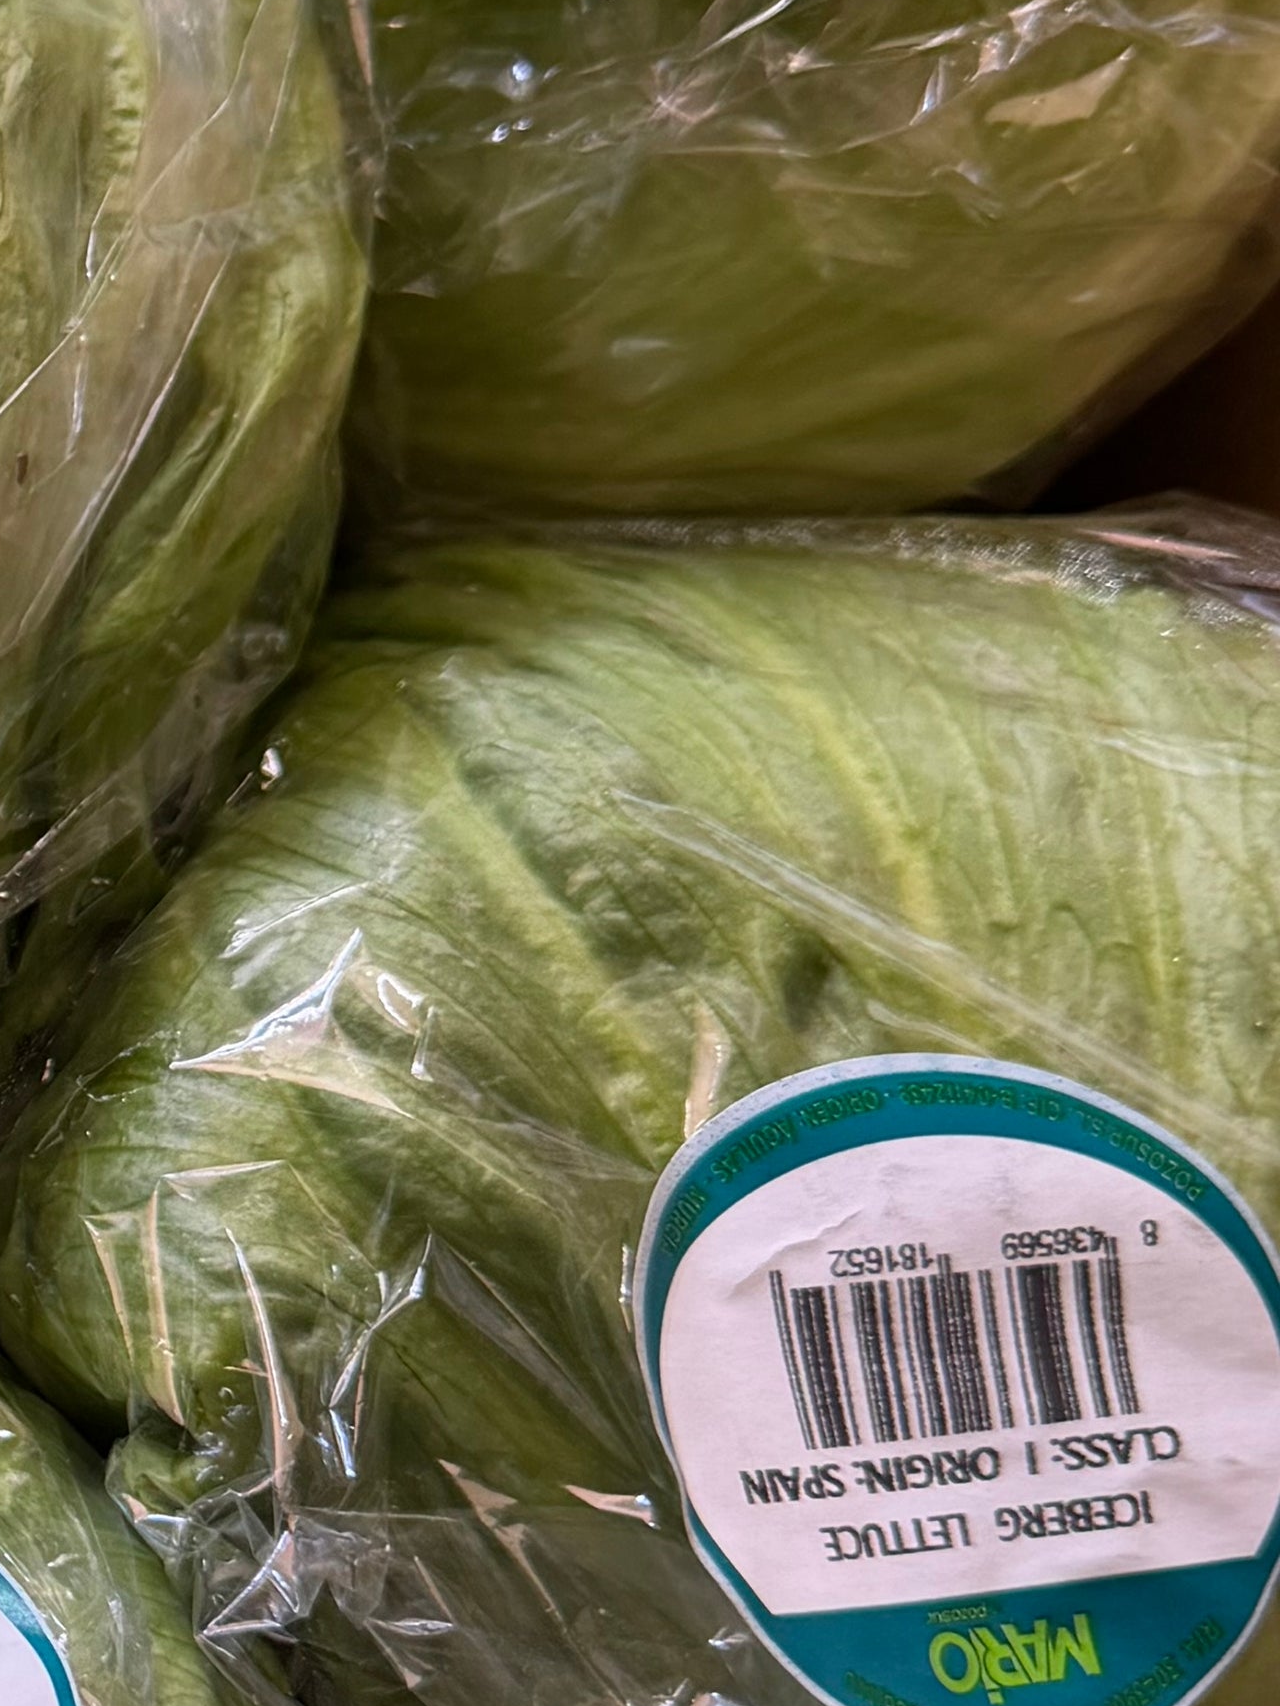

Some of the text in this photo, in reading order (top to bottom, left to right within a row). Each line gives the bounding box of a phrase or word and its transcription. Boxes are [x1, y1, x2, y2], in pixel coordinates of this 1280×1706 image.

[1109, 1128, 1204, 1201] POZOSUR
[827, 1219, 1158, 1277] 8 436569 181652
[739, 1426, 1181, 1503] CLASS: I ORIGIN: SPAIN
[819, 1490, 1153, 1561] ICEBERG LETTUCE
